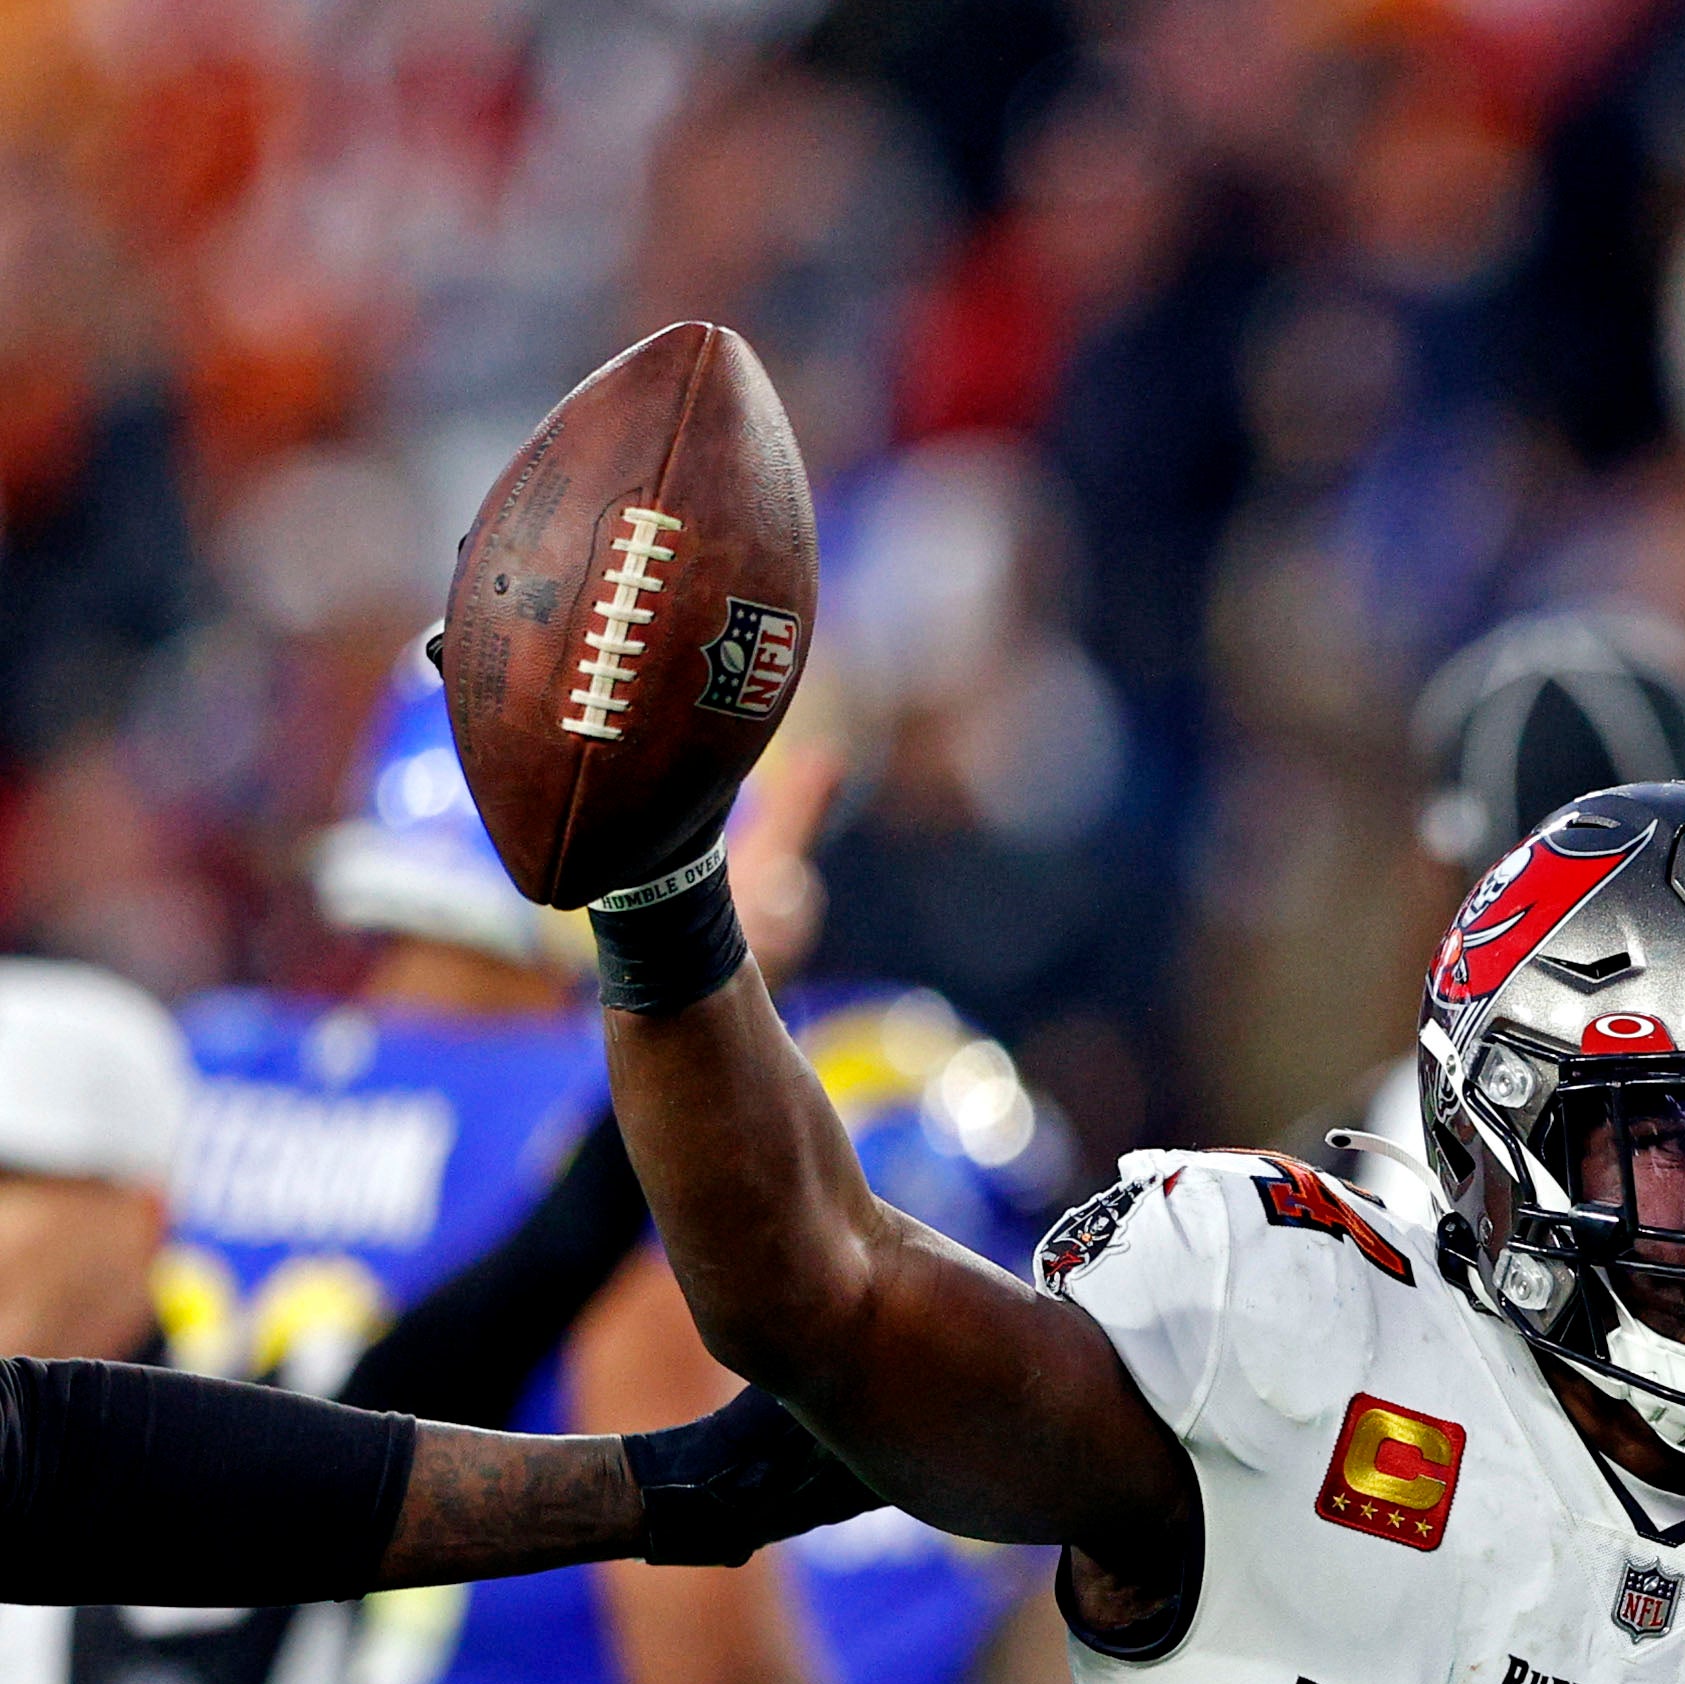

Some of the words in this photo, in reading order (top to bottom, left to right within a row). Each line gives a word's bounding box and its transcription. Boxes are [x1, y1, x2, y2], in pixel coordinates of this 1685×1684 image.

[740, 624, 796, 708] NFL
[602, 877, 679, 910] HUMBLE
[685, 850, 721, 885] OVER
[1342, 1407, 1453, 1511] C
[1620, 1592, 1667, 1629] NFL
